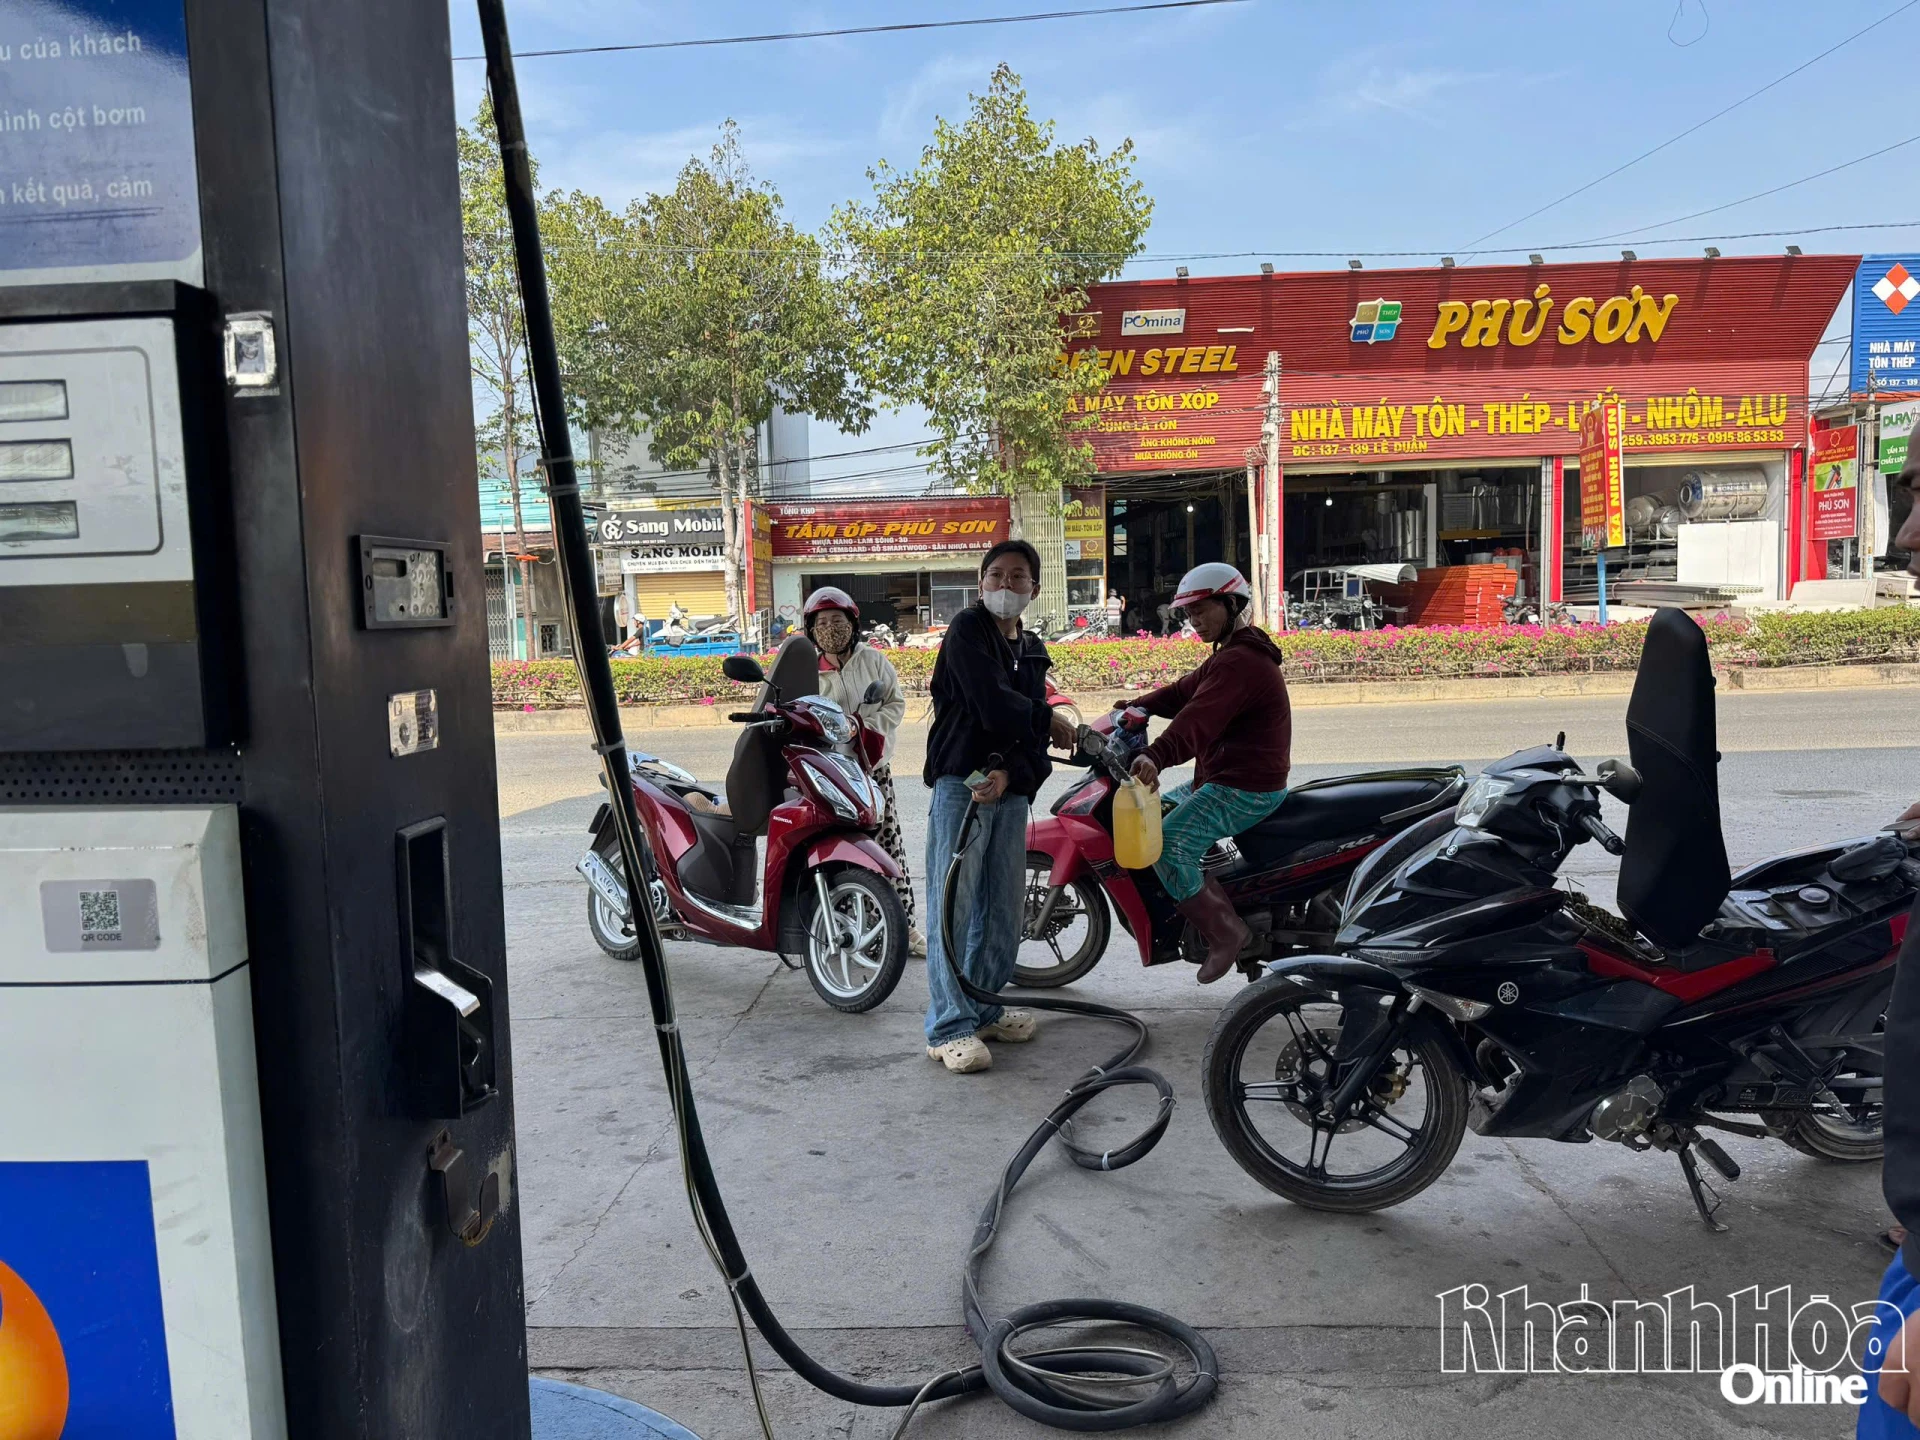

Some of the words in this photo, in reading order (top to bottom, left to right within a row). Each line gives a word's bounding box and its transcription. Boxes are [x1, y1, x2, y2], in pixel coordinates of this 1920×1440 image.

[20, 36, 61, 60] của
[70, 31, 141, 57] khách
[49, 106, 85, 132] cột
[93, 104, 146, 127] bơm
[12, 177, 46, 204] kết
[1427, 283, 1554, 349] PHÚ
[1557, 285, 1679, 344] SƠN
[1869, 340, 1890, 353] NHÀ
[1893, 339, 1915, 353] MÁY
[1140, 345, 1238, 376] STEEL
[1869, 356, 1888, 369] TÔN
[1891, 355, 1915, 368] THÉP
[1085, 391, 1126, 412] MÁY
[1133, 389, 1174, 411] TÔN
[1291, 399, 1346, 441] NHÀ
[1352, 397, 1406, 439] MÁY
[1412, 396, 1465, 437] TÔN
[1483, 393, 1551, 434] THÉP
[1646, 387, 1723, 429] NHÔM
[1736, 393, 1788, 426] ALU
[1319, 444, 1339, 455] 137
[1349, 443, 1369, 455] 139
[1373, 439, 1389, 454] LÊ
[1622, 433, 1676, 446] 259.3953
[1680, 432, 1698, 444] 775
[1609, 456, 1620, 507] NINH
[800, 507, 816, 515] KHO
[1818, 498, 1833, 511] PHÚ
[626, 519, 668, 536] Sang
[785, 520, 837, 538] TẤM
[842, 520, 877, 537] ỐP
[883, 518, 936, 536] PHÚ
[941, 519, 997, 534] SƠN
[631, 548, 674, 559] SANG
[678, 546, 726, 557] MOBIL
[81, 933, 95, 942] QR
[97, 933, 122, 941] CODE
